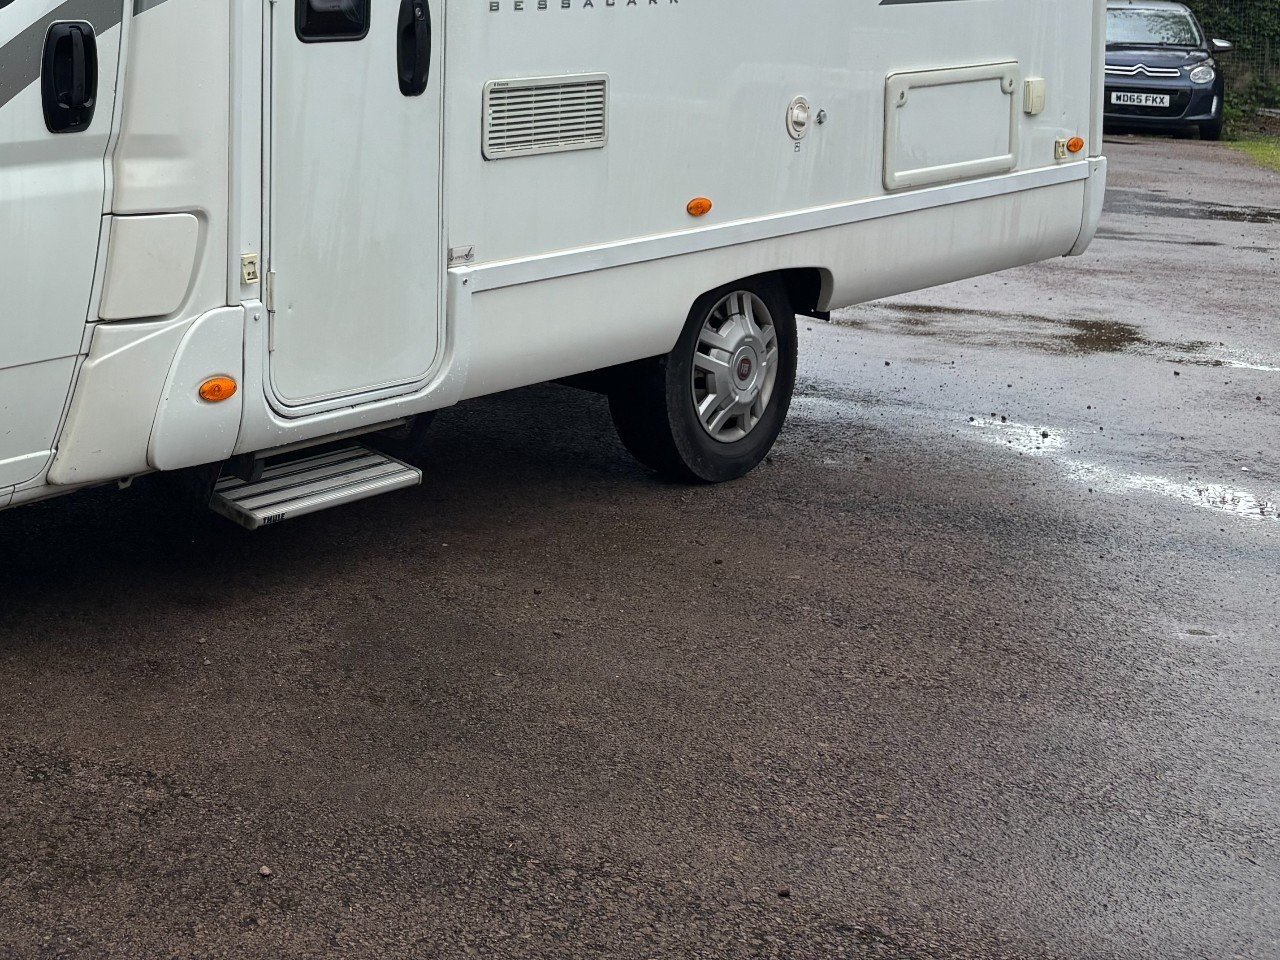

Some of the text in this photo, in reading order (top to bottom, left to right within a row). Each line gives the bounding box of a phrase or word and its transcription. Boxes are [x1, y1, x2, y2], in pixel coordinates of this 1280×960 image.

[1115, 94, 1165, 105] WD65 FKX
[262, 512, 287, 525] THULE
